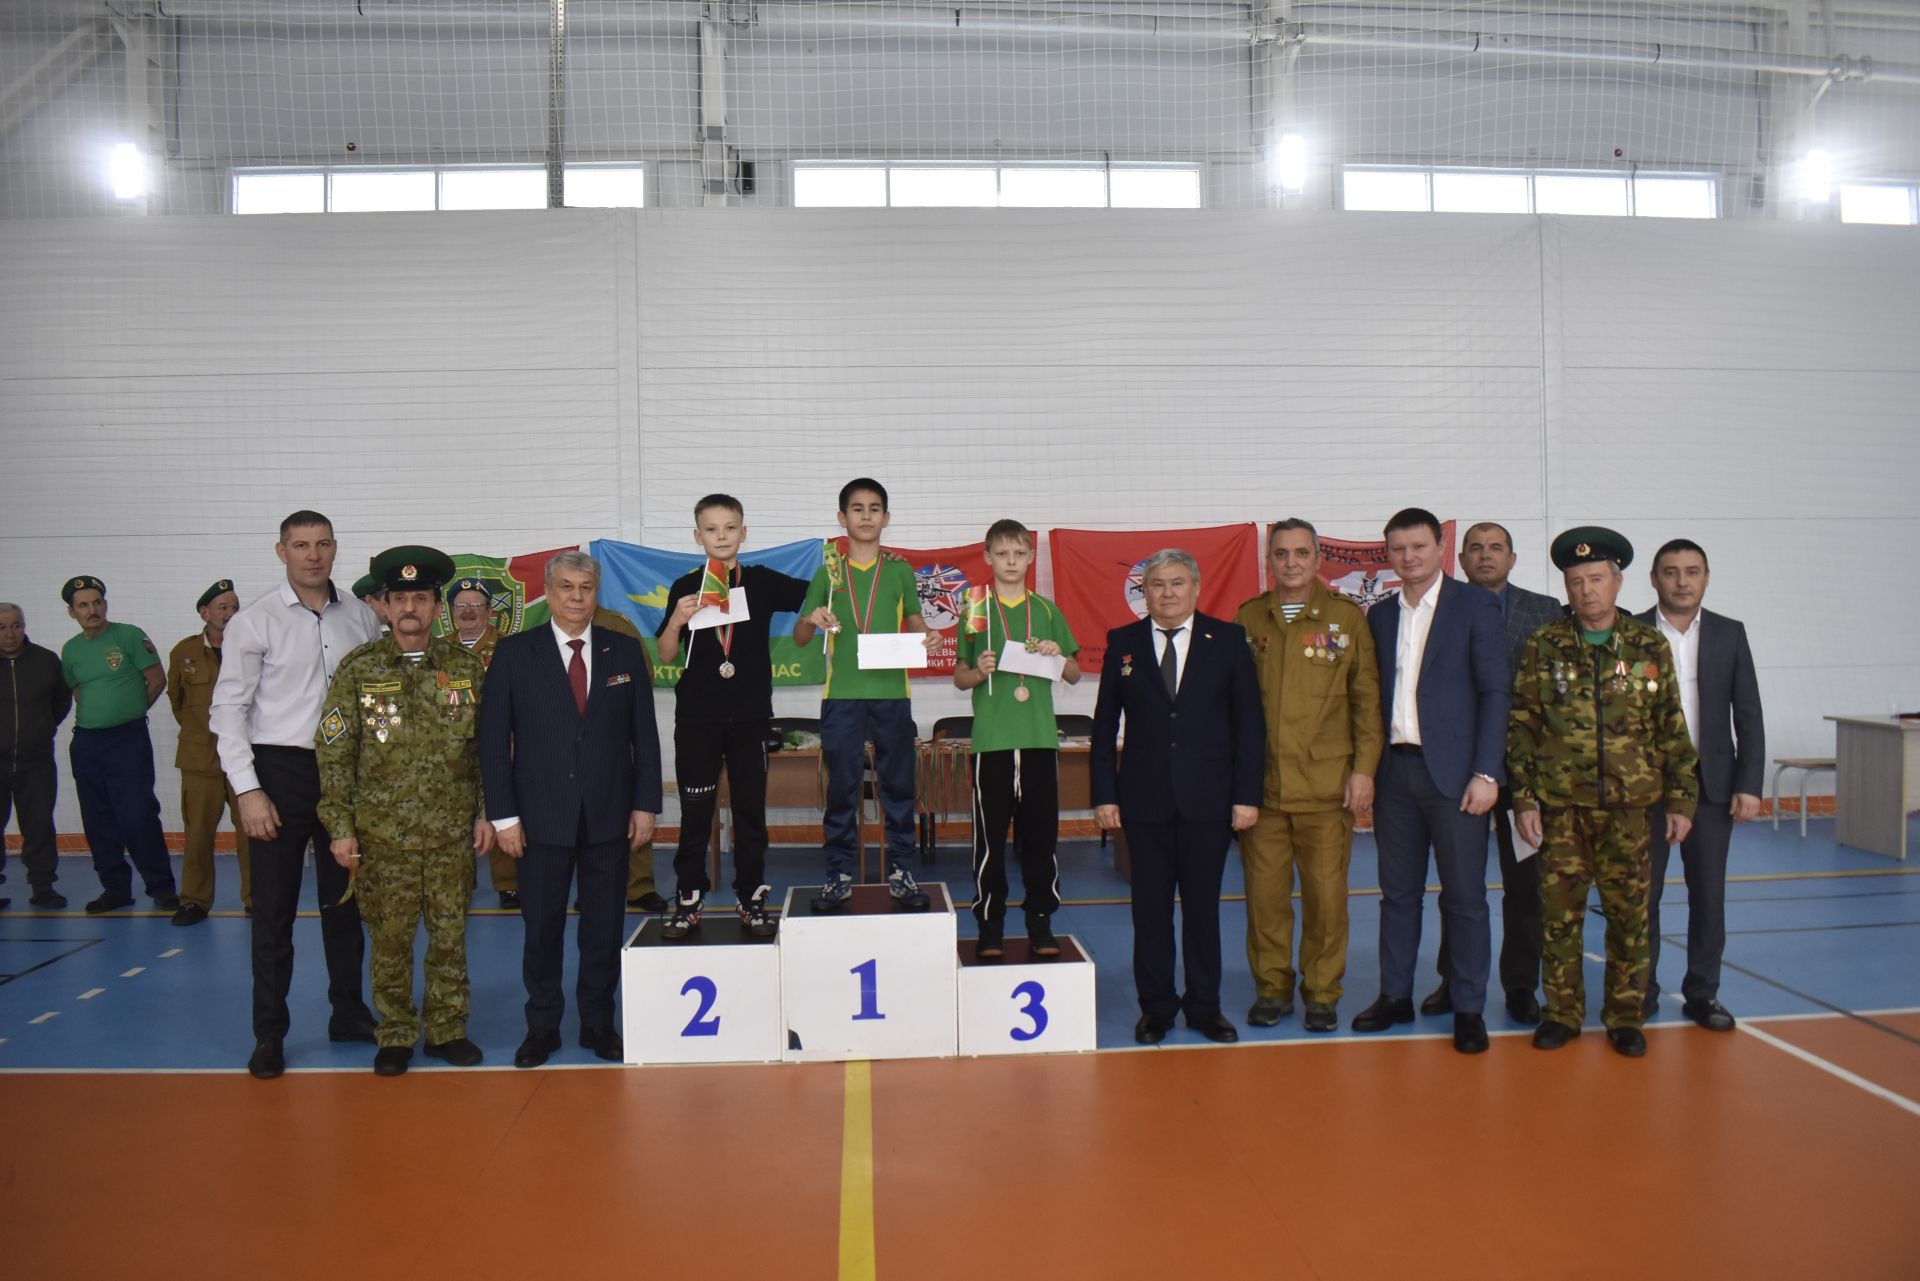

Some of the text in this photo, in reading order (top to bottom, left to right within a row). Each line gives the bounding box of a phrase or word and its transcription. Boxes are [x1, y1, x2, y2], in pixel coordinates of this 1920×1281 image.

[511, 596, 523, 635] ЧНИКОВ
[680, 976, 721, 1037] 2
[850, 959, 886, 1021] 1
[1010, 981, 1049, 1041] 3
